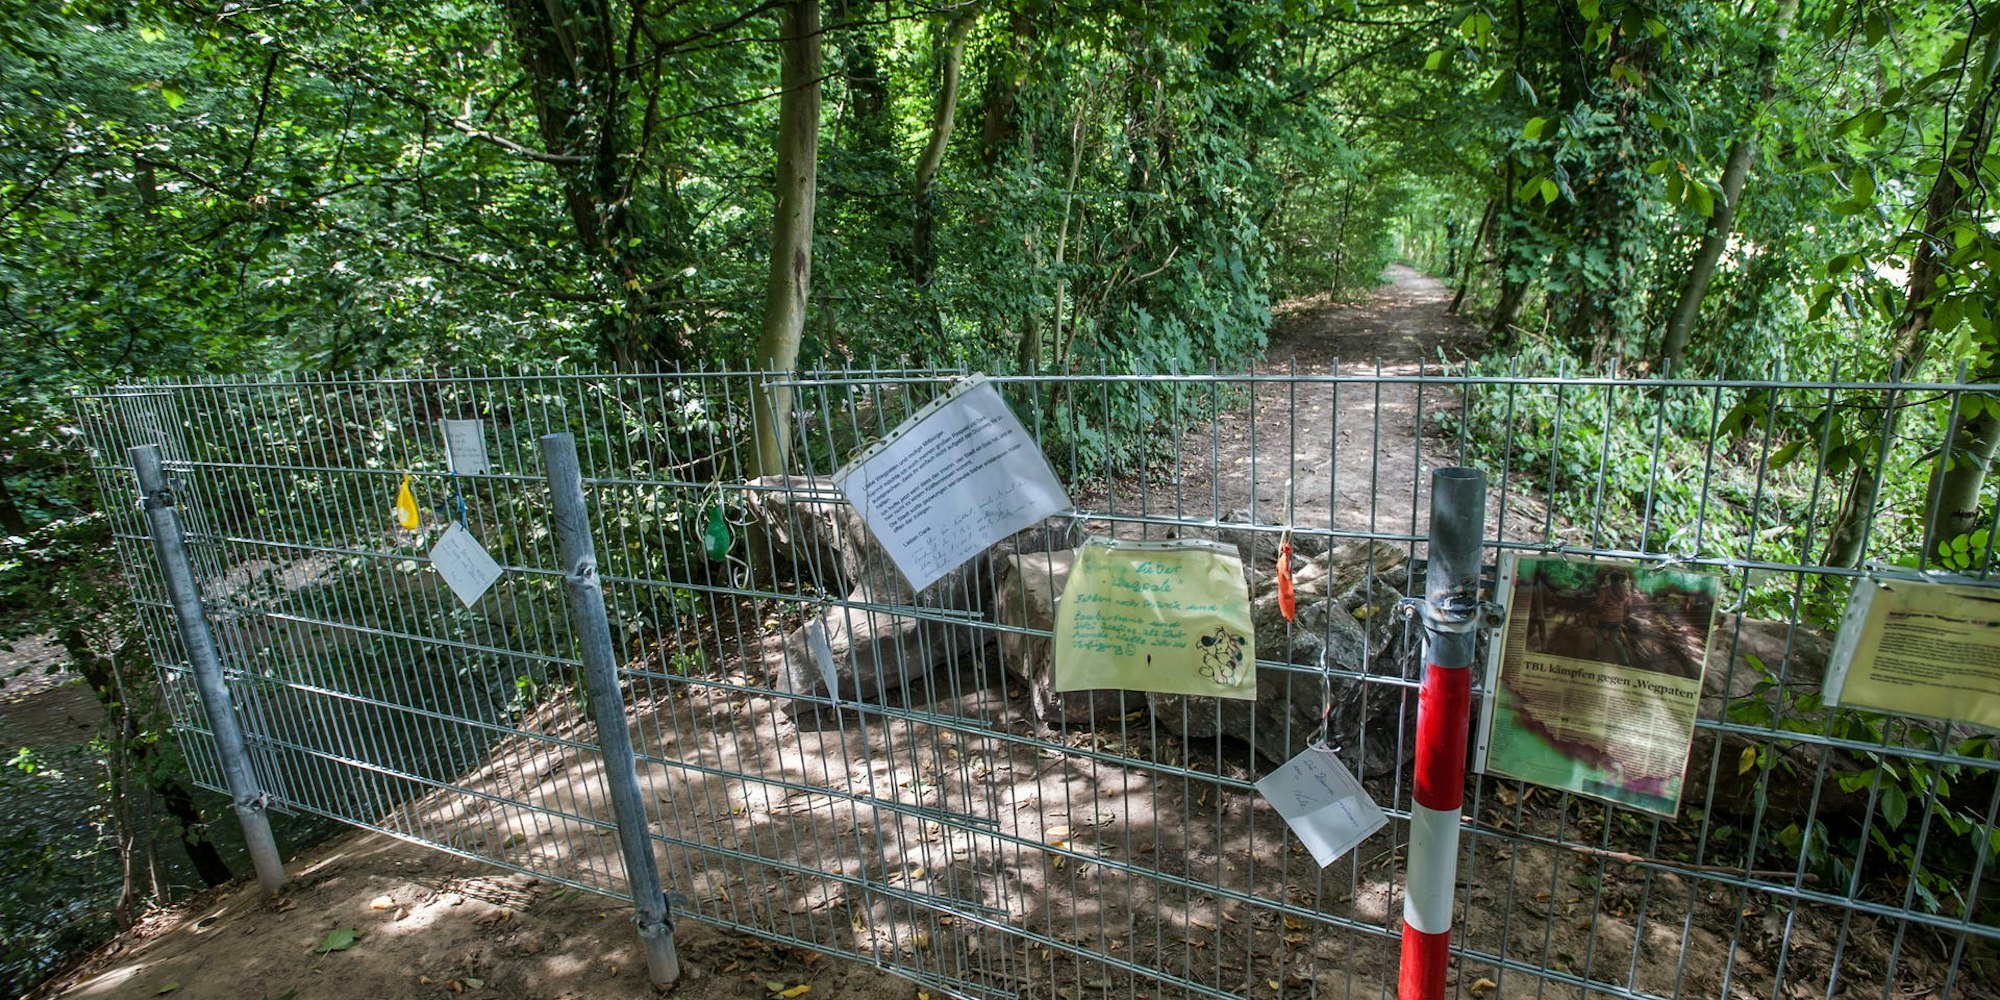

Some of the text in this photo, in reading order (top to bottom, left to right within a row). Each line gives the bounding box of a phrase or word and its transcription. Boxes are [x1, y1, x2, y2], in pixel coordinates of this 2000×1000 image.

[1523, 660, 1547, 673] TBL
[1549, 663, 1596, 680] kämpfen
[1598, 674, 1631, 687] gegen
